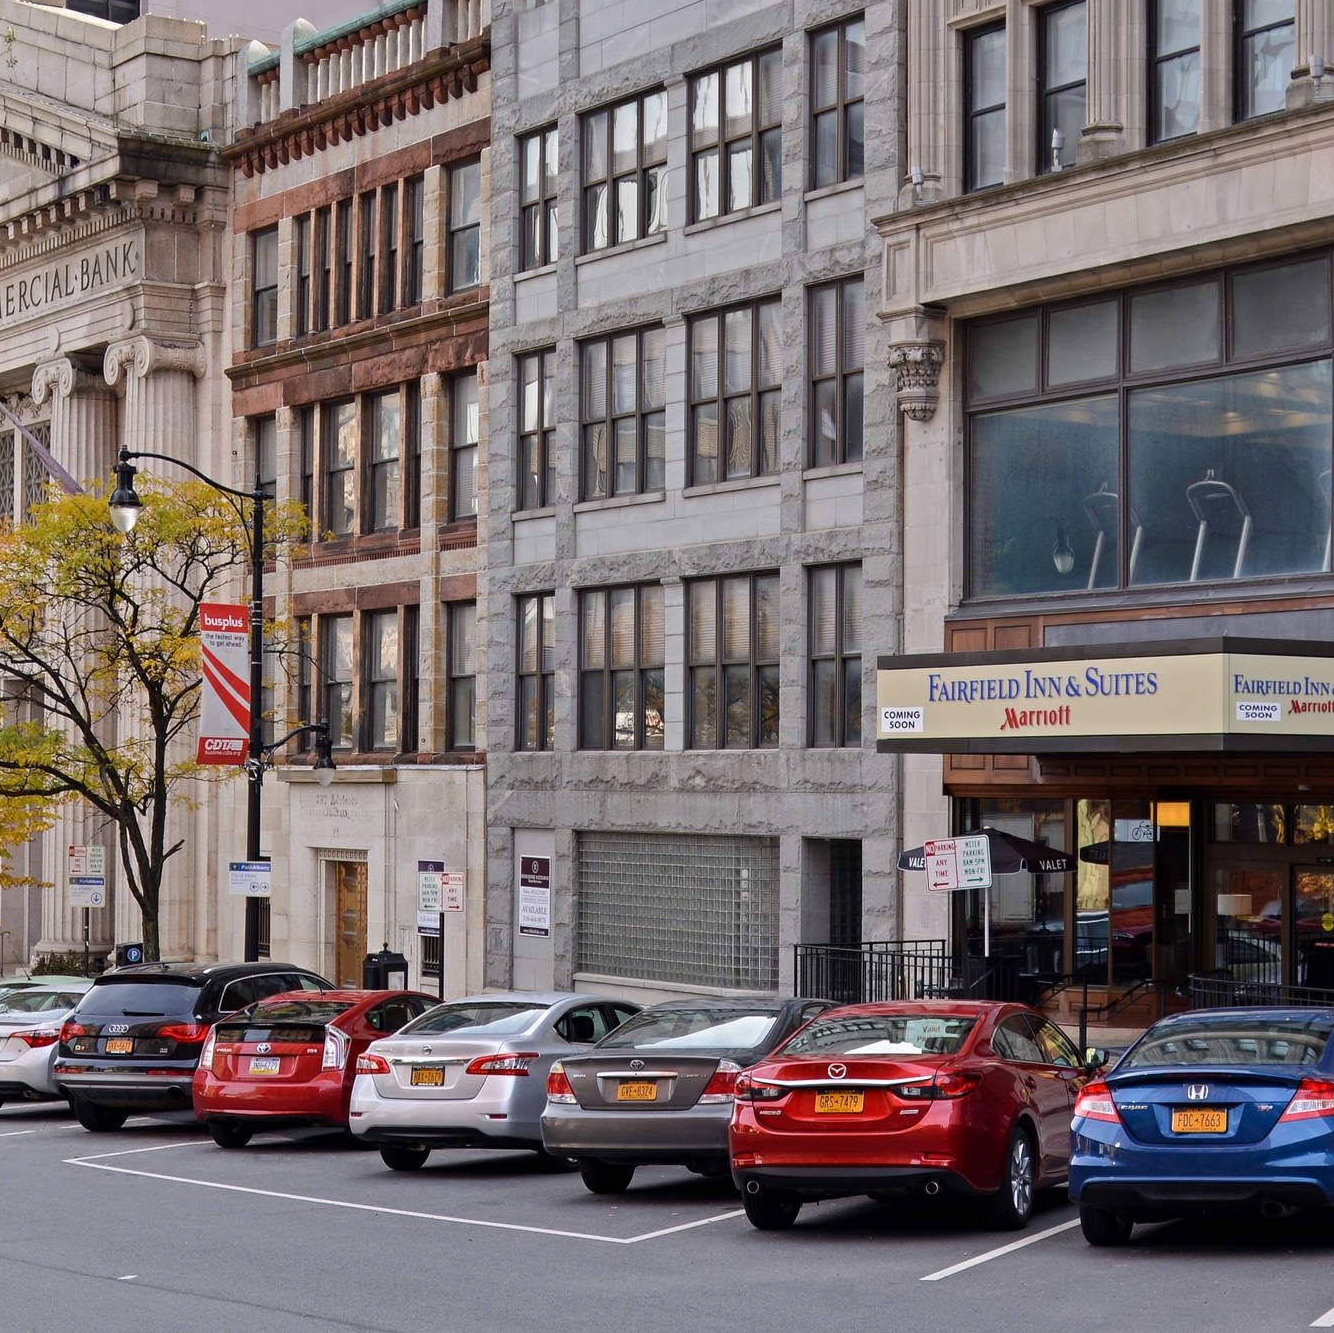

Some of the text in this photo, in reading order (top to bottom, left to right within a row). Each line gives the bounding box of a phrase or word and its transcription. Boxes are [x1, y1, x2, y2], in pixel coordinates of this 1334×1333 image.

[80, 241, 136, 291] BANK
[204, 613, 243, 630] busplus
[928, 666, 1159, 703] FAIRFIELD INN & SUITES
[1234, 674, 1302, 697] FAIRFIELD
[1304, 676, 1330, 696] INN
[1239, 704, 1278, 712] COMING
[884, 710, 921, 720] COMING
[1000, 705, 1071, 731] Marriott
[889, 720, 915, 730] SOON
[935, 843, 955, 853] PARKING
[965, 840, 981, 848] METER
[962, 849, 985, 857] PARKING
[909, 857, 926, 868] VALE
[1039, 858, 1067, 871] VALET
[935, 870, 949, 878] TIME
[522, 905, 548, 915] AVAILABLE
